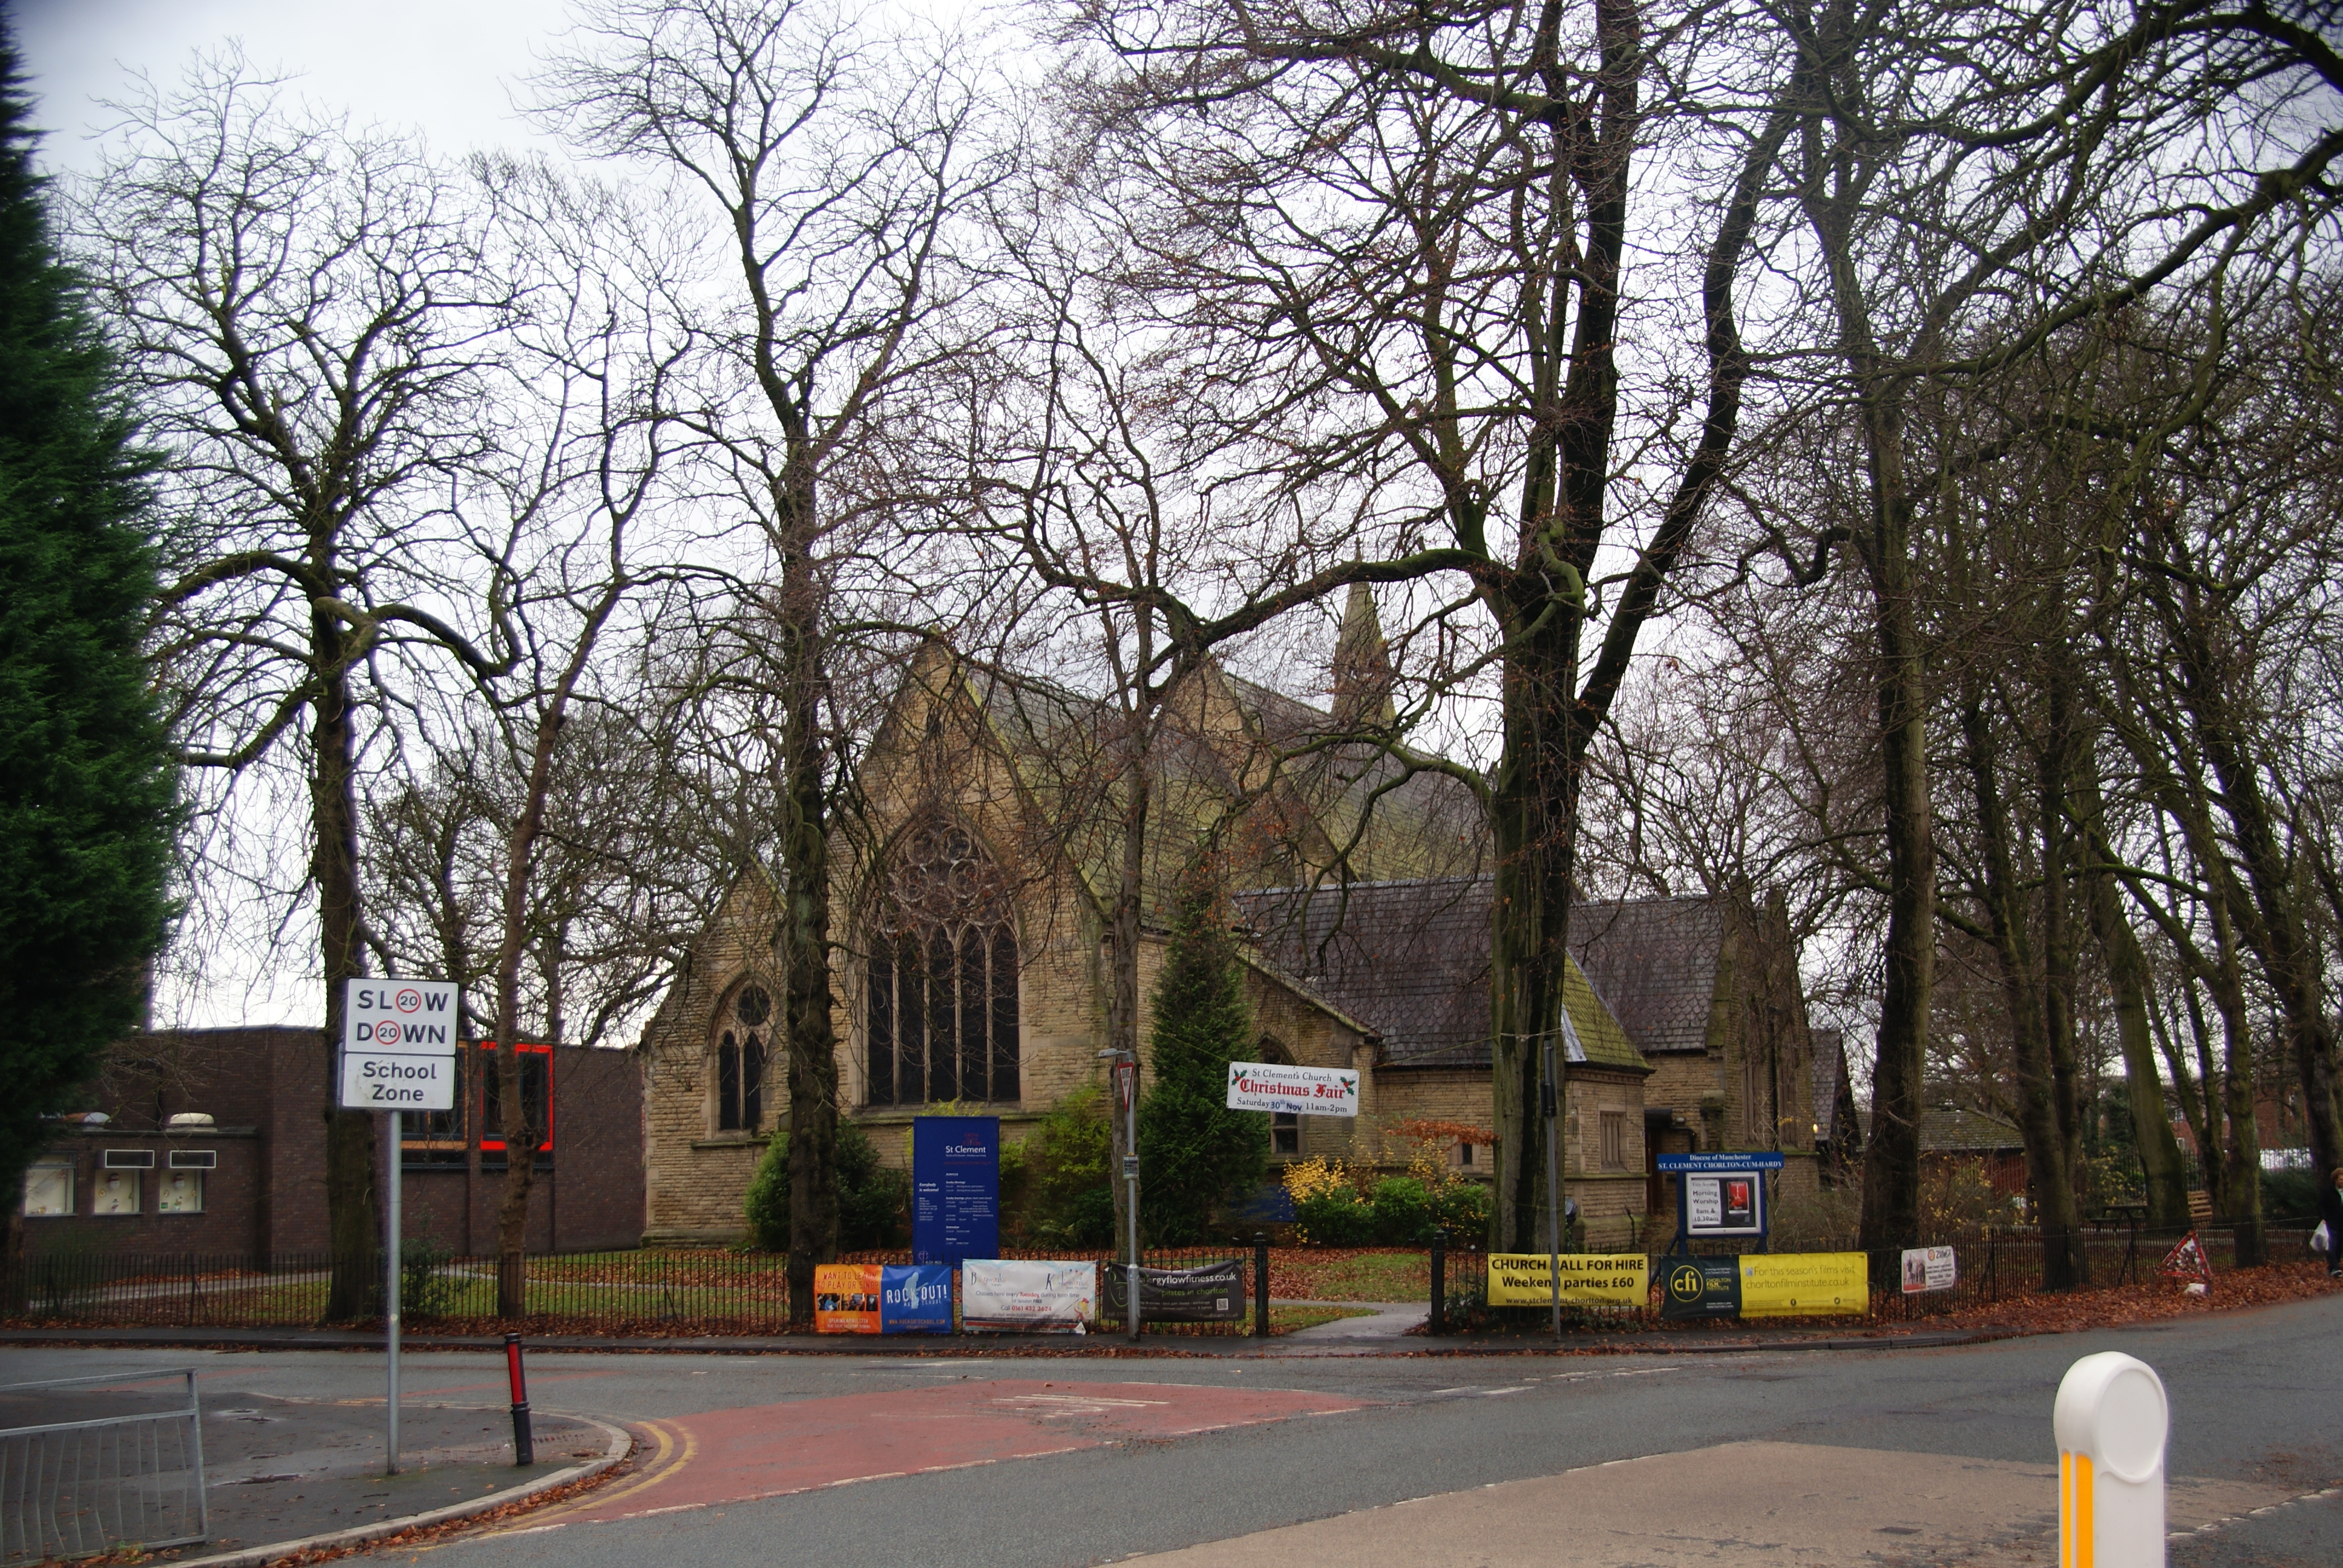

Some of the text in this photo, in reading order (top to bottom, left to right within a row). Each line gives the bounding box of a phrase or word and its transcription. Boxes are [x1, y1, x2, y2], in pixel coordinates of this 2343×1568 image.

[362, 1061, 437, 1079] School
[1252, 1068, 1332, 1082] St Clement's Church
[372, 1083, 424, 1101] Zone
[1240, 1079, 1346, 1099] Christmas Fair
[1237, 1097, 1270, 1108] Saturday
[1271, 1099, 1285, 1109] 30th
[1306, 1102, 1347, 1113] 11am-2pm
[1492, 1259, 1546, 1270] CHURCH
[1587, 1259, 1612, 1270] FOR
[1616, 1259, 1643, 1270] HIRE
[1754, 1264, 1855, 1276] For this season's films visit
[854, 1272, 876, 1280] LEARN
[1502, 1276, 1634, 1290] Weeken parties £60
[1674, 1270, 1697, 1292] cfi
[859, 1281, 879, 1290] SING?
[1746, 1278, 1849, 1289] chorltonfilminstitute.co.uk
[886, 1284, 947, 1303] ROCK OUT!
[1506, 1296, 1632, 1305] www.stclemnt-chorlton.org.uk
